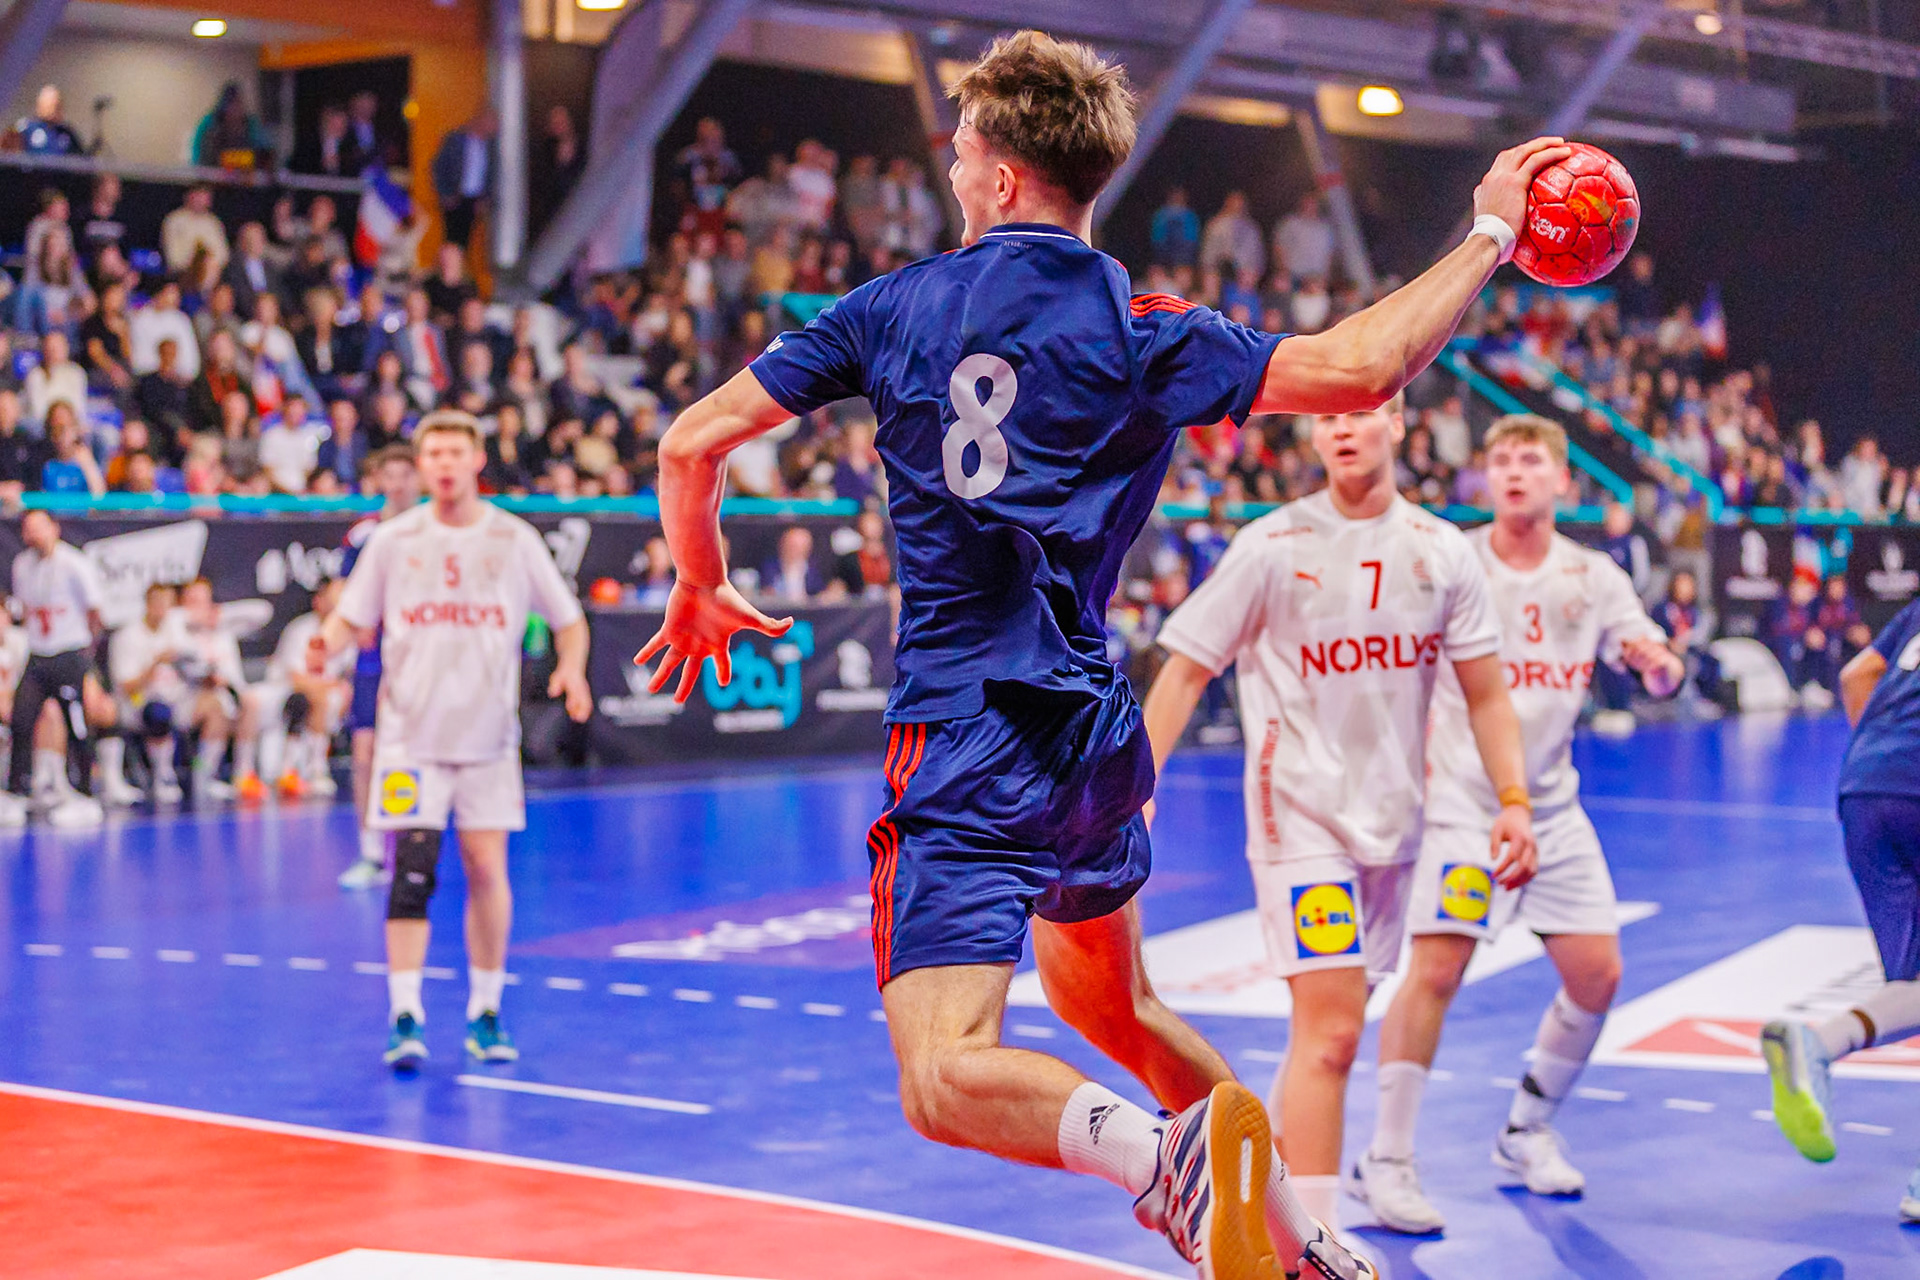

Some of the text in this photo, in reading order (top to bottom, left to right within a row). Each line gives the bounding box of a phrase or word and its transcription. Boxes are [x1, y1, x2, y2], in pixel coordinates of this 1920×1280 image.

[942, 353, 1018, 500] 8
[445, 553, 461, 589] 5
[1360, 560, 1382, 610] 7
[1524, 603, 1543, 643] 3
[1300, 632, 1442, 679] NORLYS
[1092, 1102, 1120, 1146] adidas
